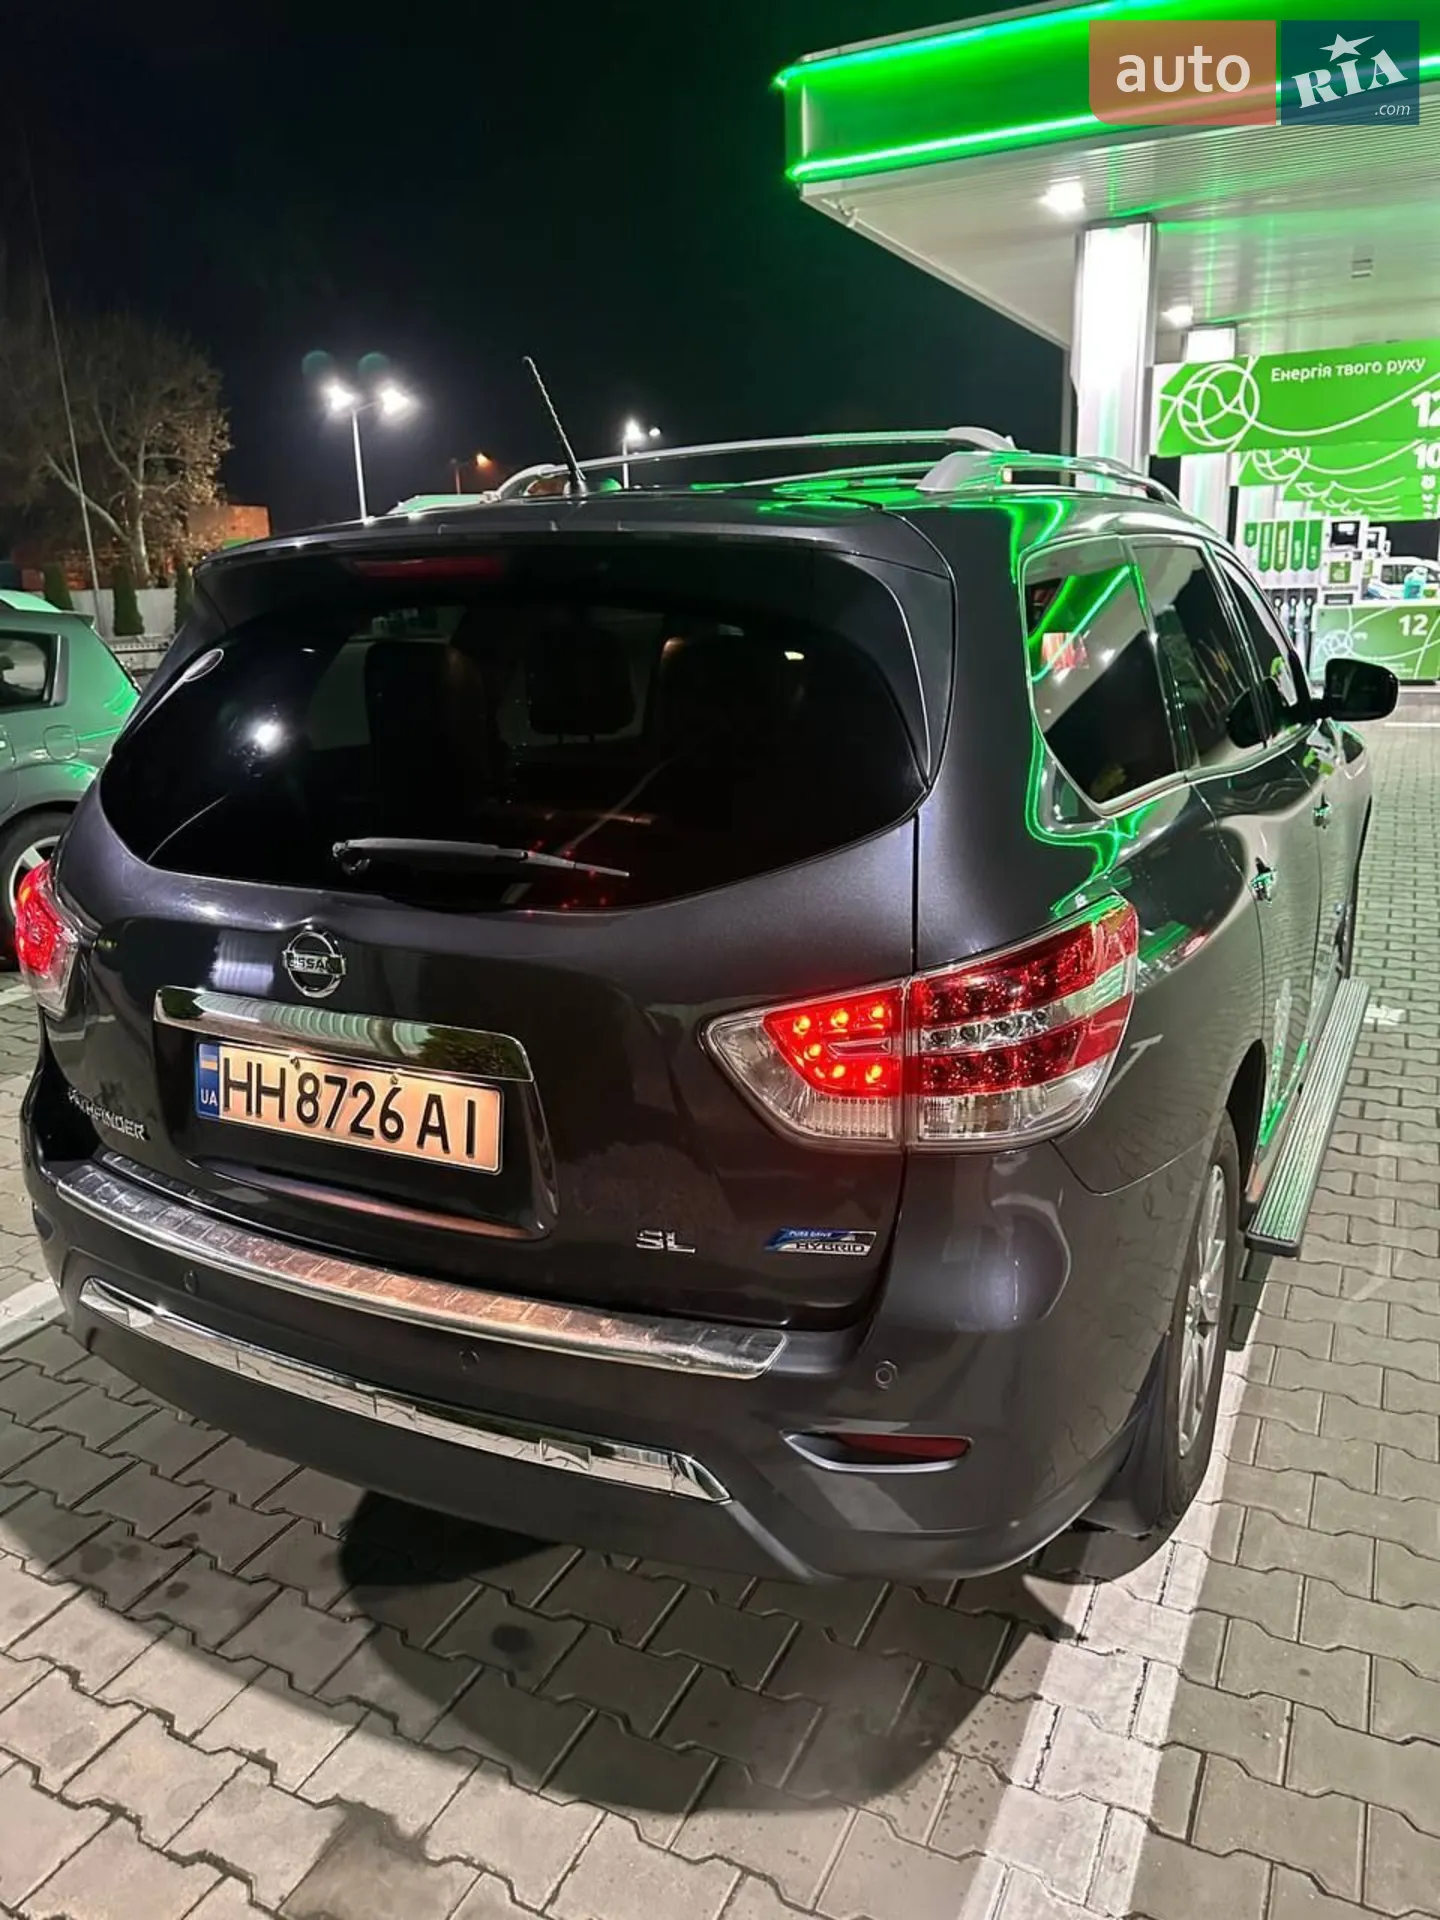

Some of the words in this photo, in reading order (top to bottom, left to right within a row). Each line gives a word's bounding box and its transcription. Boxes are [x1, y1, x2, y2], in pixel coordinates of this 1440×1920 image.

[1271, 363, 1332, 383] Енергія
[1335, 360, 1383, 377] твого
[1386, 357, 1426, 375] руху
[1399, 613, 1429, 637] 12
[200, 1087, 218, 1106] UA
[636, 1230, 696, 1254] SL
[795, 1242, 865, 1253] HYBRID
